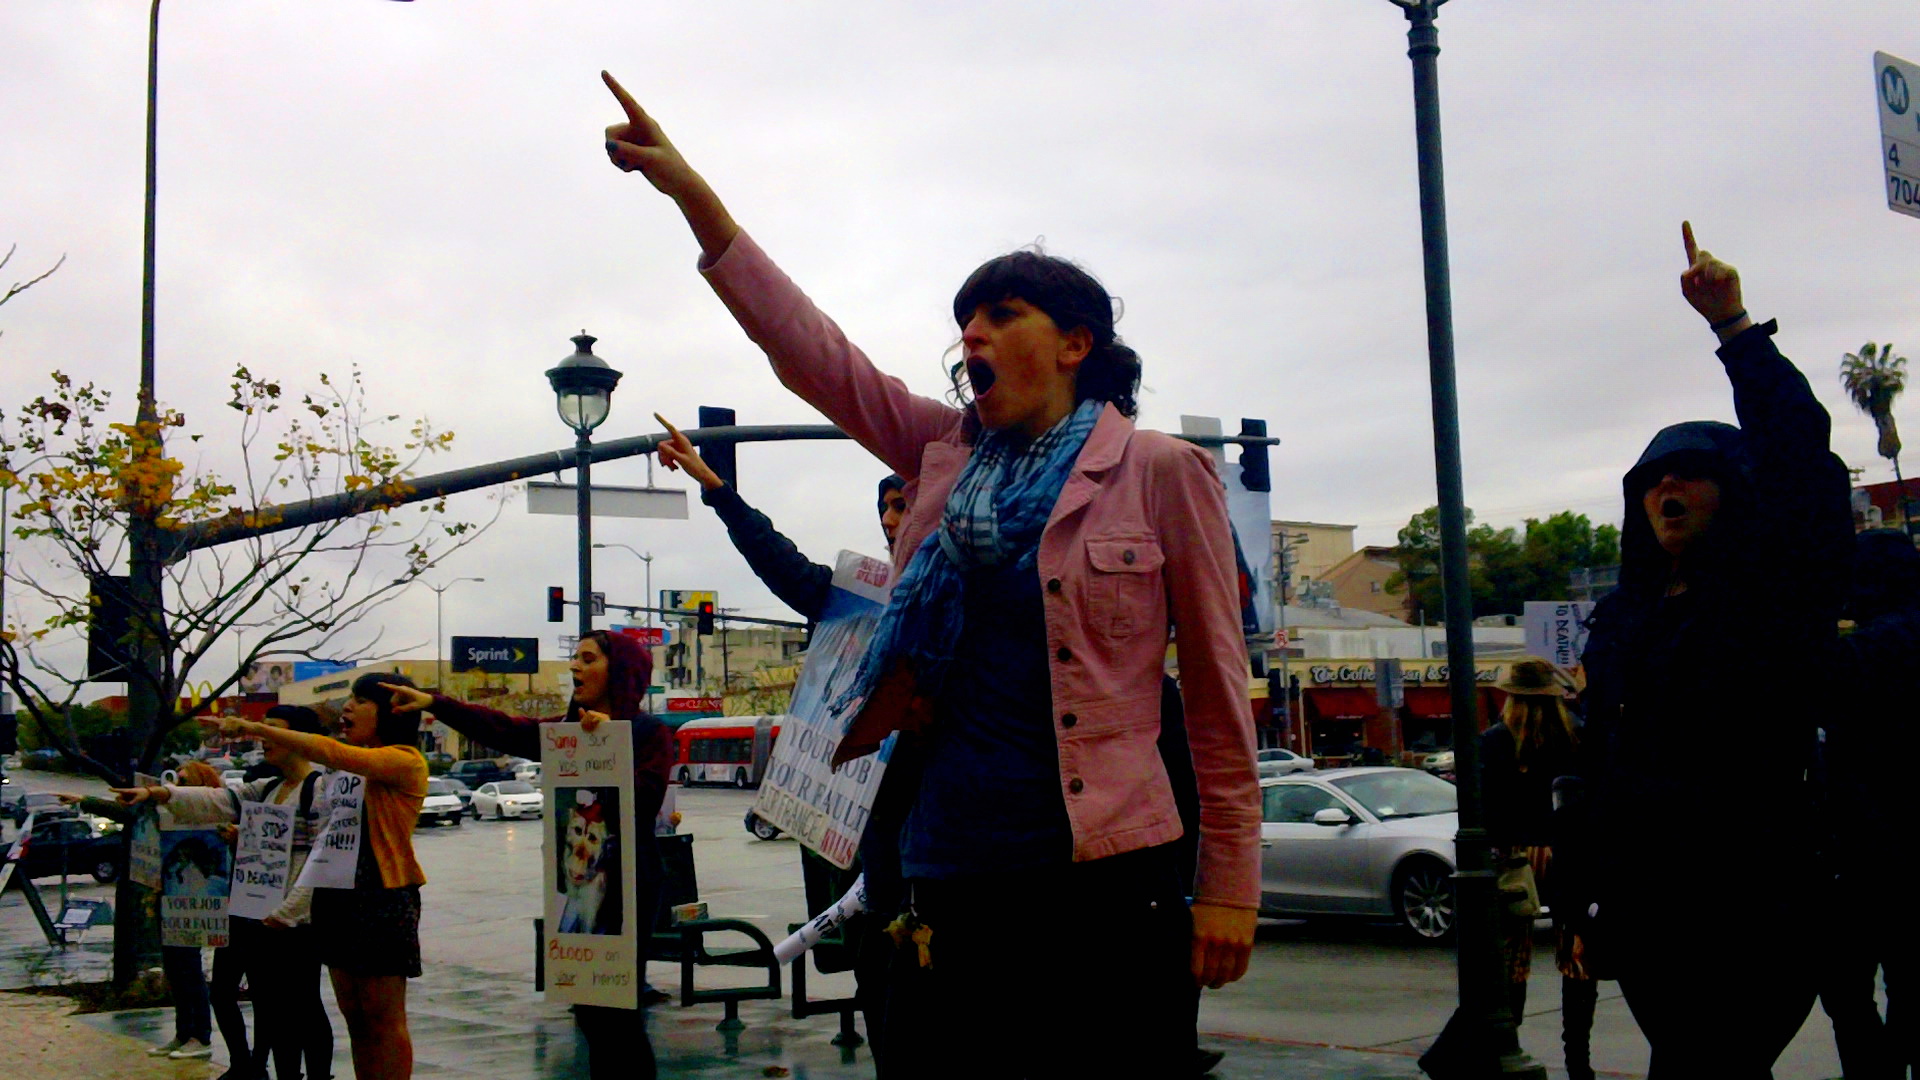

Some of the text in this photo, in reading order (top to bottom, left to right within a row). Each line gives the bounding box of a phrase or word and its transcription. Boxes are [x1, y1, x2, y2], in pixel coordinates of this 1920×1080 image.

[1888, 142, 1900, 169] 4
[1890, 175, 1920, 206] 704
[1556, 604, 1570, 617] TO
[467, 646, 510, 665] Sprint
[1339, 664, 1376, 681] Coffe
[789, 723, 872, 785] YOUR OB
[767, 757, 870, 832] YOUR FAULT
[261, 821, 289, 839] STOP
[819, 827, 857, 865] KILLS
[167, 897, 222, 911] YOUR JOB
[193, 917, 228, 931] FAULT
